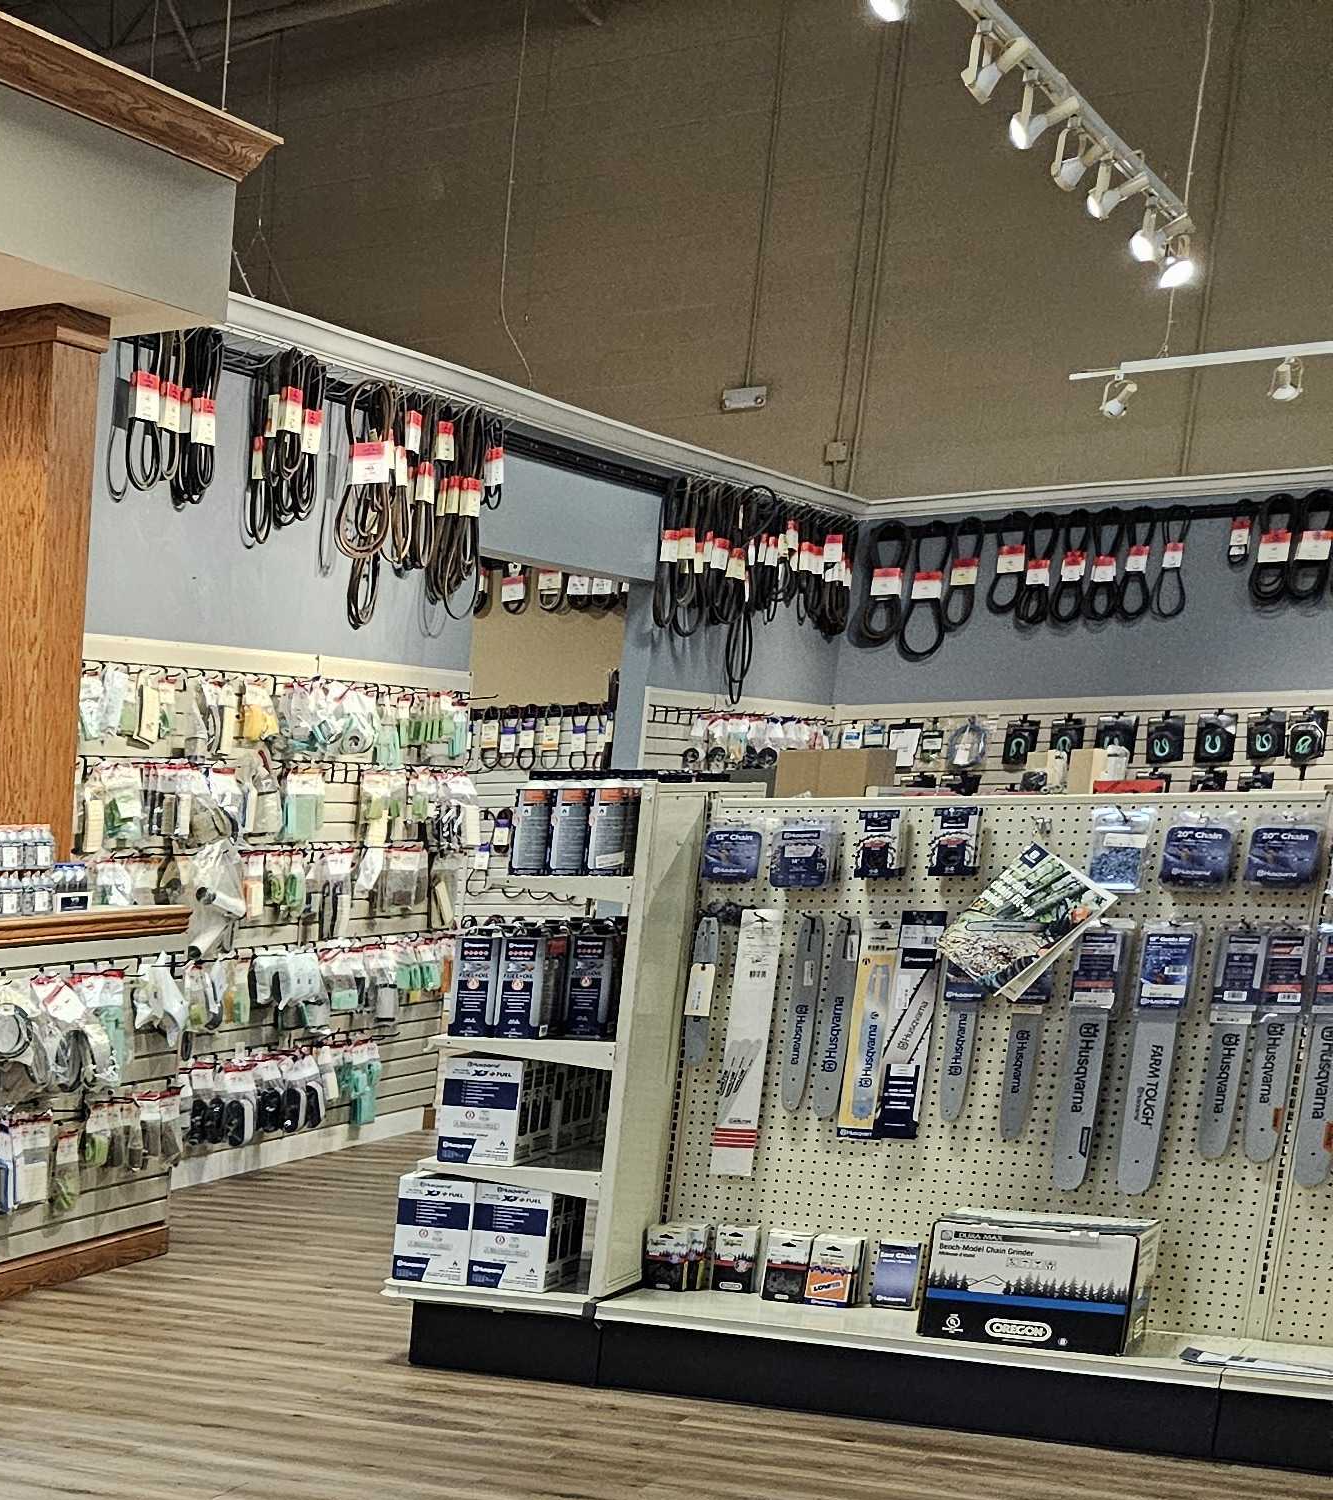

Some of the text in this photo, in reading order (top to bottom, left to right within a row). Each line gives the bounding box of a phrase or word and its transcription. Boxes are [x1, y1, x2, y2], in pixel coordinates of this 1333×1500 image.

[1195, 831, 1223, 840] Chain
[1281, 832, 1309, 841] Chain
[792, 1011, 805, 1065] Husqvarna
[825, 996, 844, 1059] Husqvarna
[902, 1001, 929, 1045] Husqvarna
[952, 1013, 968, 1066] Husqvarna
[862, 1024, 878, 1077] Husqvarna
[1011, 1041, 1028, 1094] Husqvarna
[1071, 1039, 1094, 1113] Husqvarna
[1259, 1037, 1282, 1104] Husqvarna
[1141, 1044, 1164, 1126] FARM TOUGH
[1213, 1047, 1236, 1114] Husqvarna
[1312, 1042, 1333, 1120] Husqvarna
[939, 1242, 985, 1253] Bench-Model
[986, 1246, 1006, 1255] Chain
[1007, 1247, 1035, 1257] Grinder
[992, 1321, 1044, 1338] OREGON
